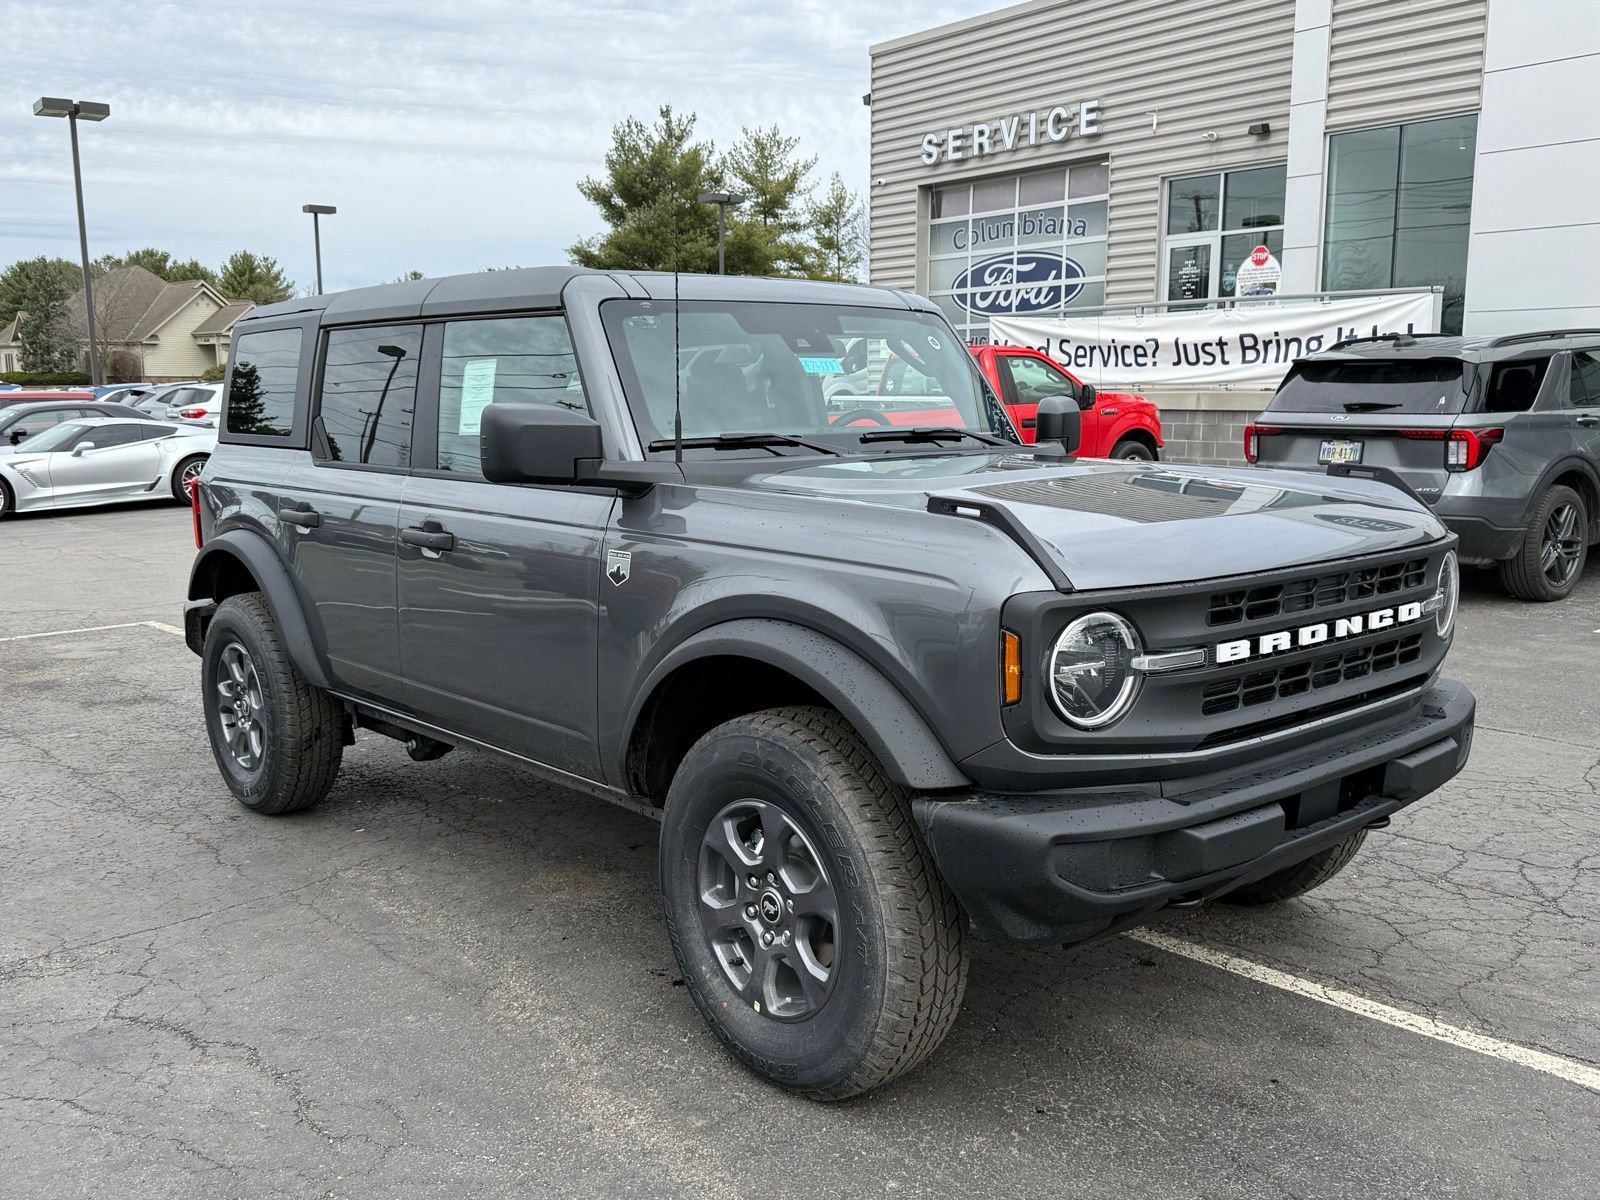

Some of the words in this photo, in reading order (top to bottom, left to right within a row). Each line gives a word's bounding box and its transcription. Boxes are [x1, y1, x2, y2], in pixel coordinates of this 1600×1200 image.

[921, 99, 1103, 166] SERVICE
[953, 212, 1087, 250] Columbiana
[1252, 252, 1269, 260] STOP
[975, 262, 1057, 308] Ford
[1058, 338, 1160, 367] Service?
[1172, 336, 1230, 366] Just
[1239, 331, 1324, 364] Bring
[1216, 602, 1421, 663] BRONCO
[737, 751, 860, 889] DUELER
